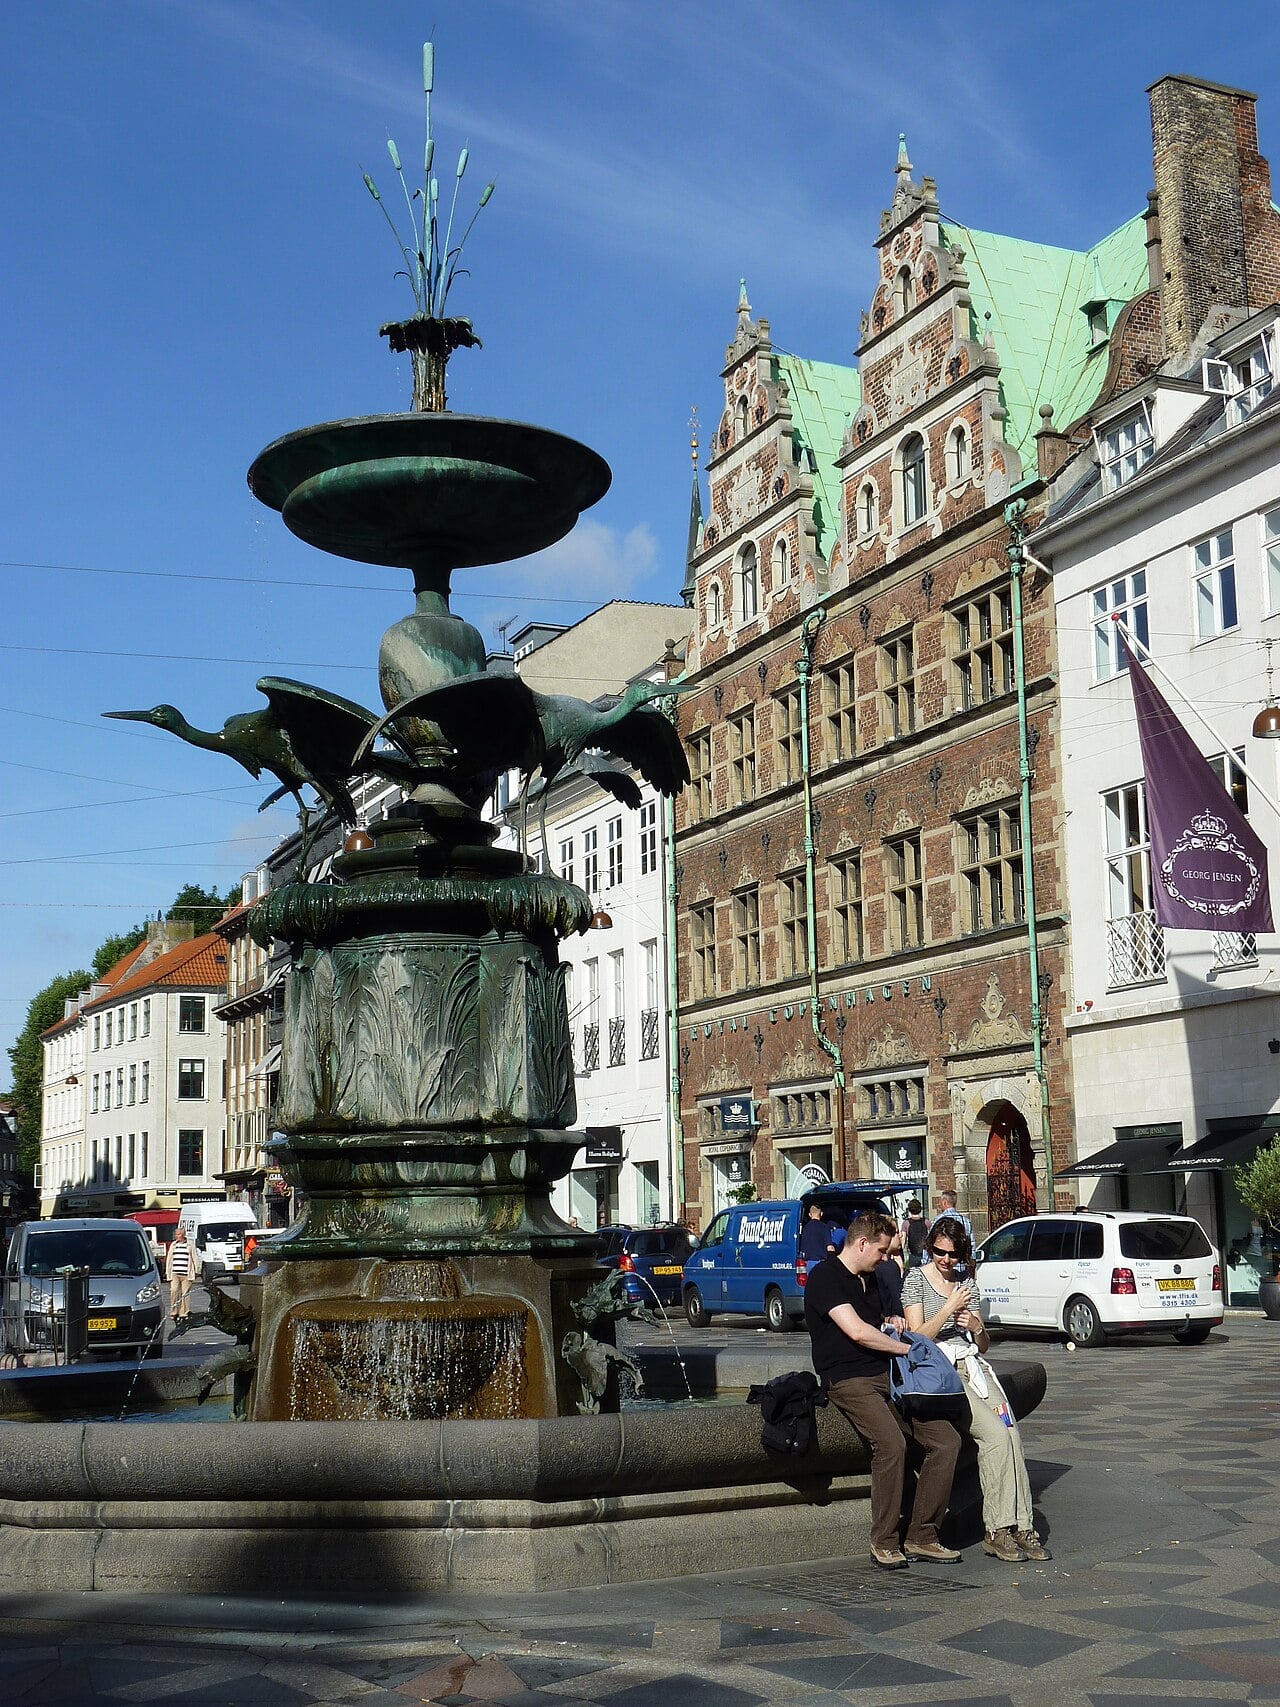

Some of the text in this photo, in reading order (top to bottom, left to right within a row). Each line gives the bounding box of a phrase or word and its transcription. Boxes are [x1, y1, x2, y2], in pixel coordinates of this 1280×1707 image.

[1182, 869, 1242, 883] GEORG JENSEN
[689, 975, 932, 1040] ROYAL COPNHAGEN
[1134, 1126, 1168, 1136] GEORG JENSEN
[738, 1214, 786, 1249] Bundgaard
[1160, 1280, 1171, 1288] VK
[100, 1319, 113, 1328] 952
